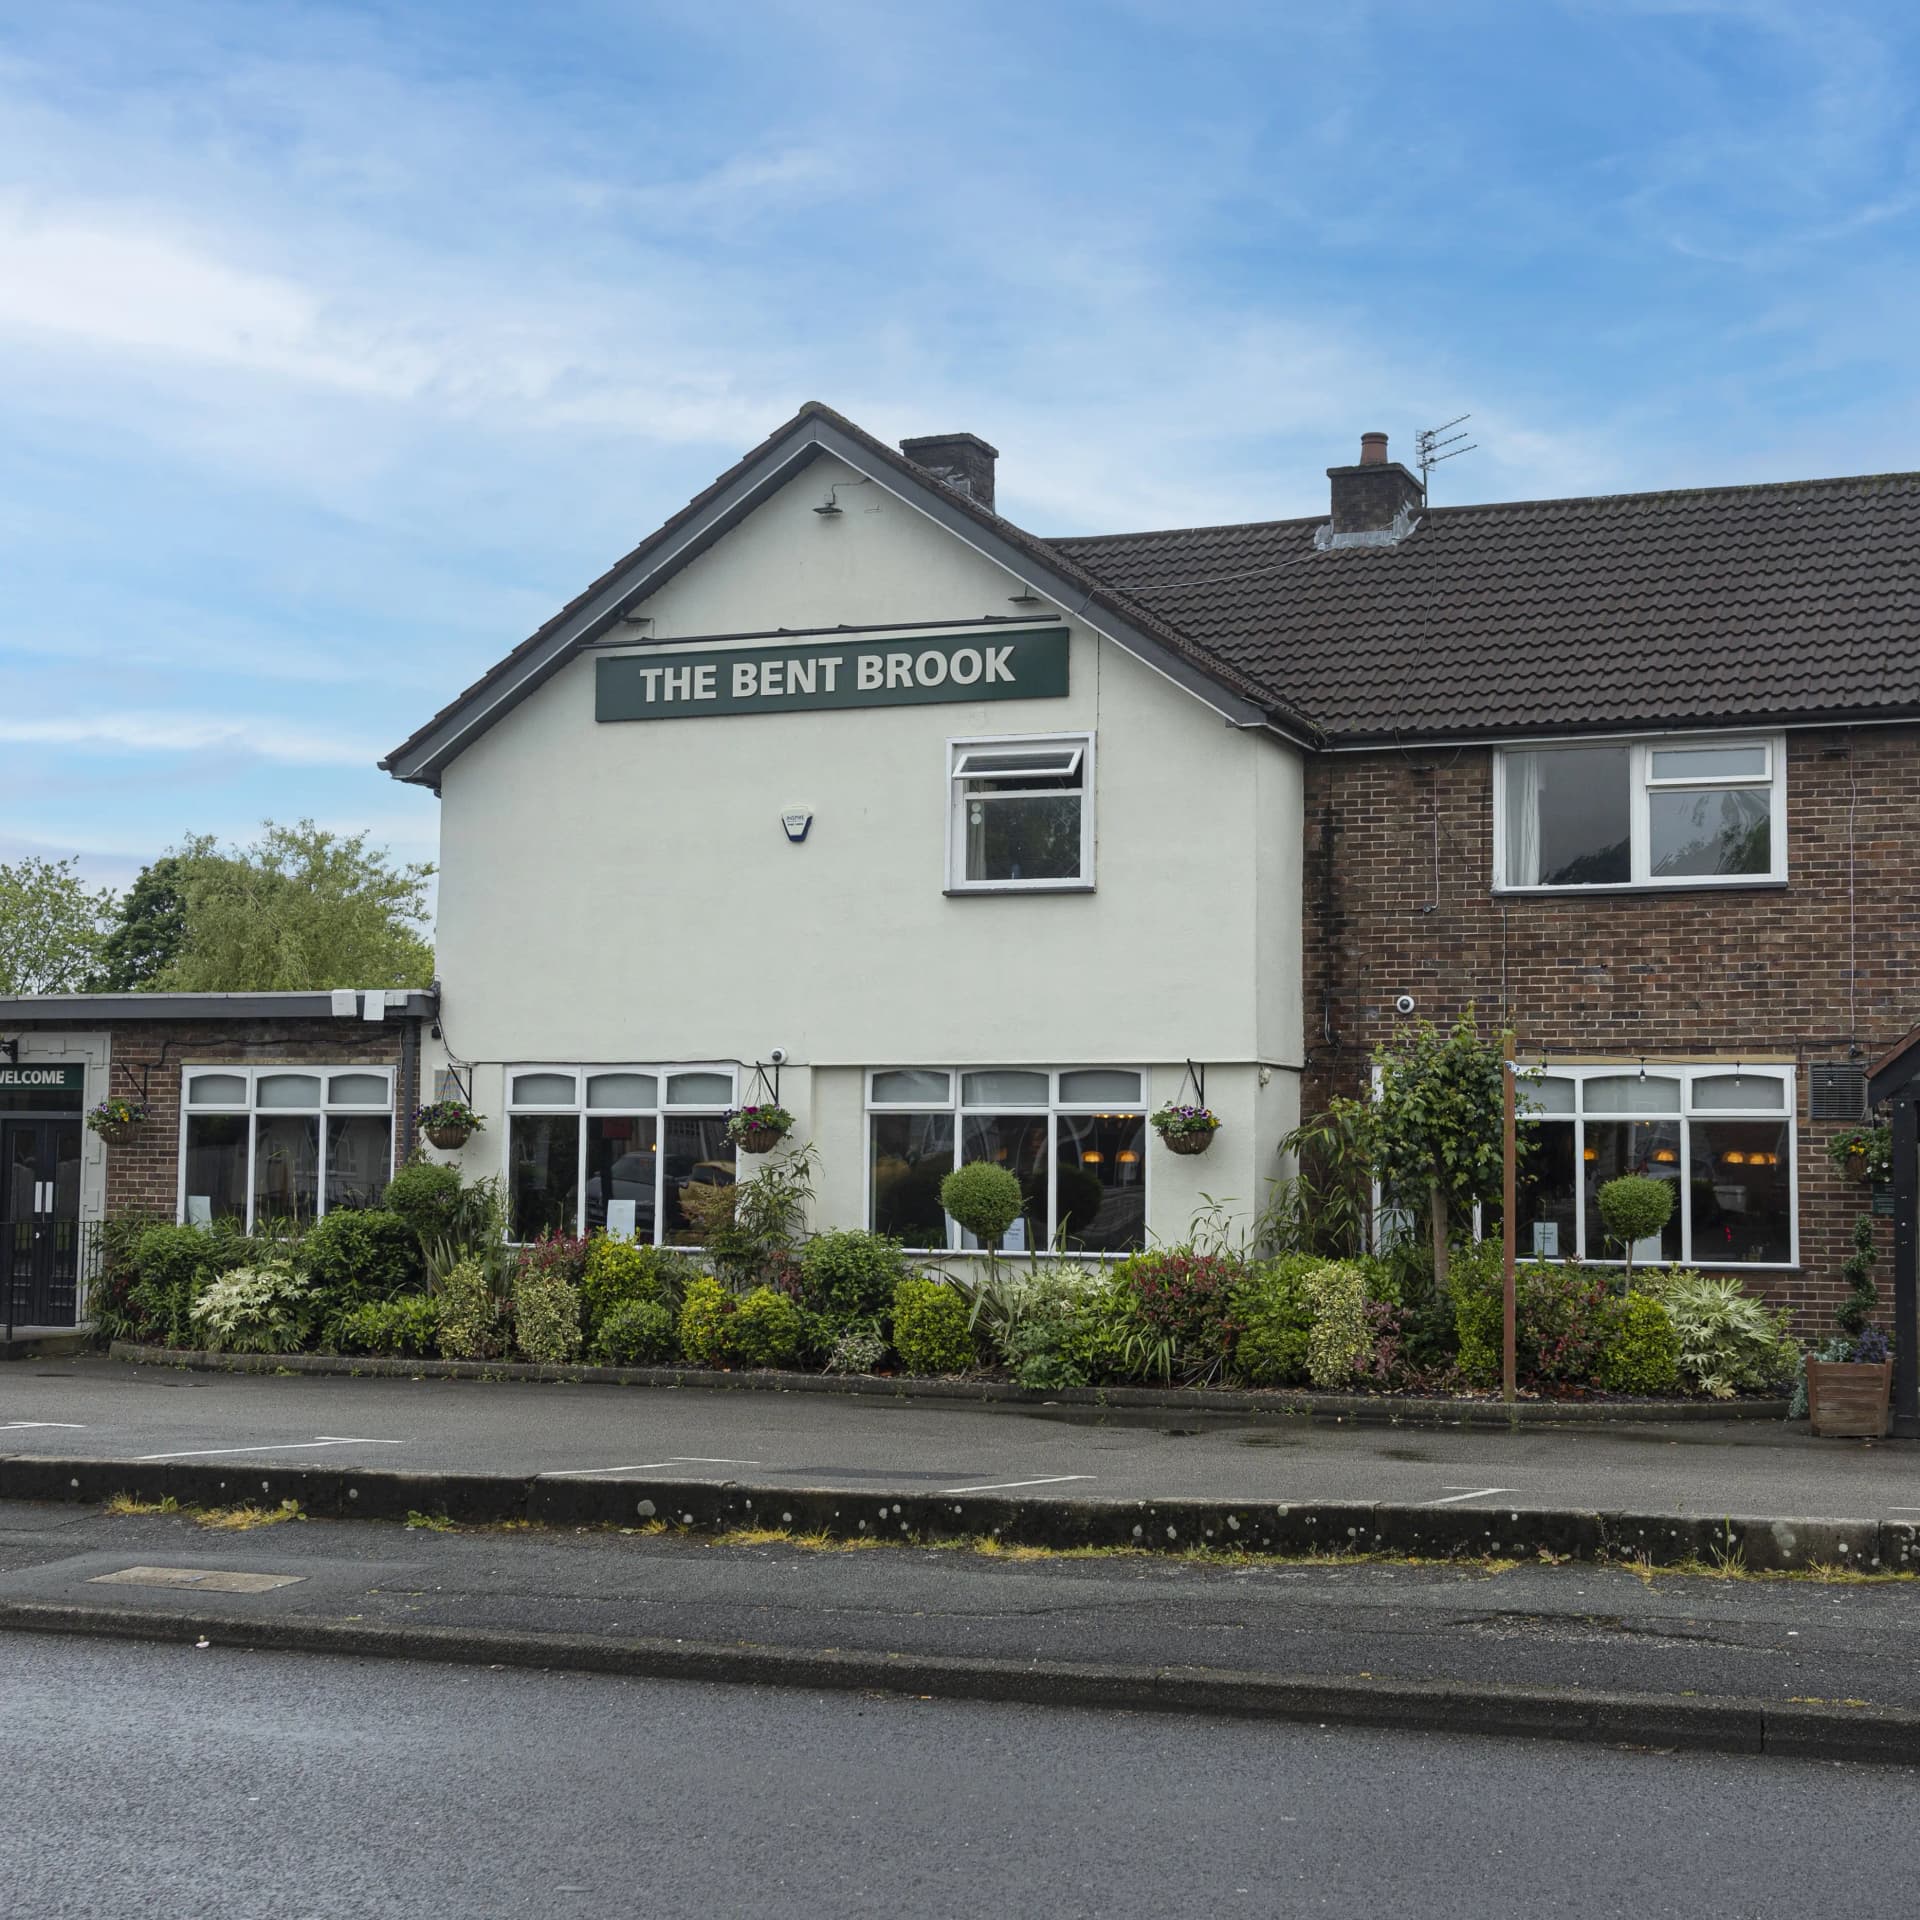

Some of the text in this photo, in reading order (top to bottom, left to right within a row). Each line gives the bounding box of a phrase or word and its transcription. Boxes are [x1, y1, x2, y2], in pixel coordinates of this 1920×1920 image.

[639, 646, 1016, 702] THE BENT BROOK
